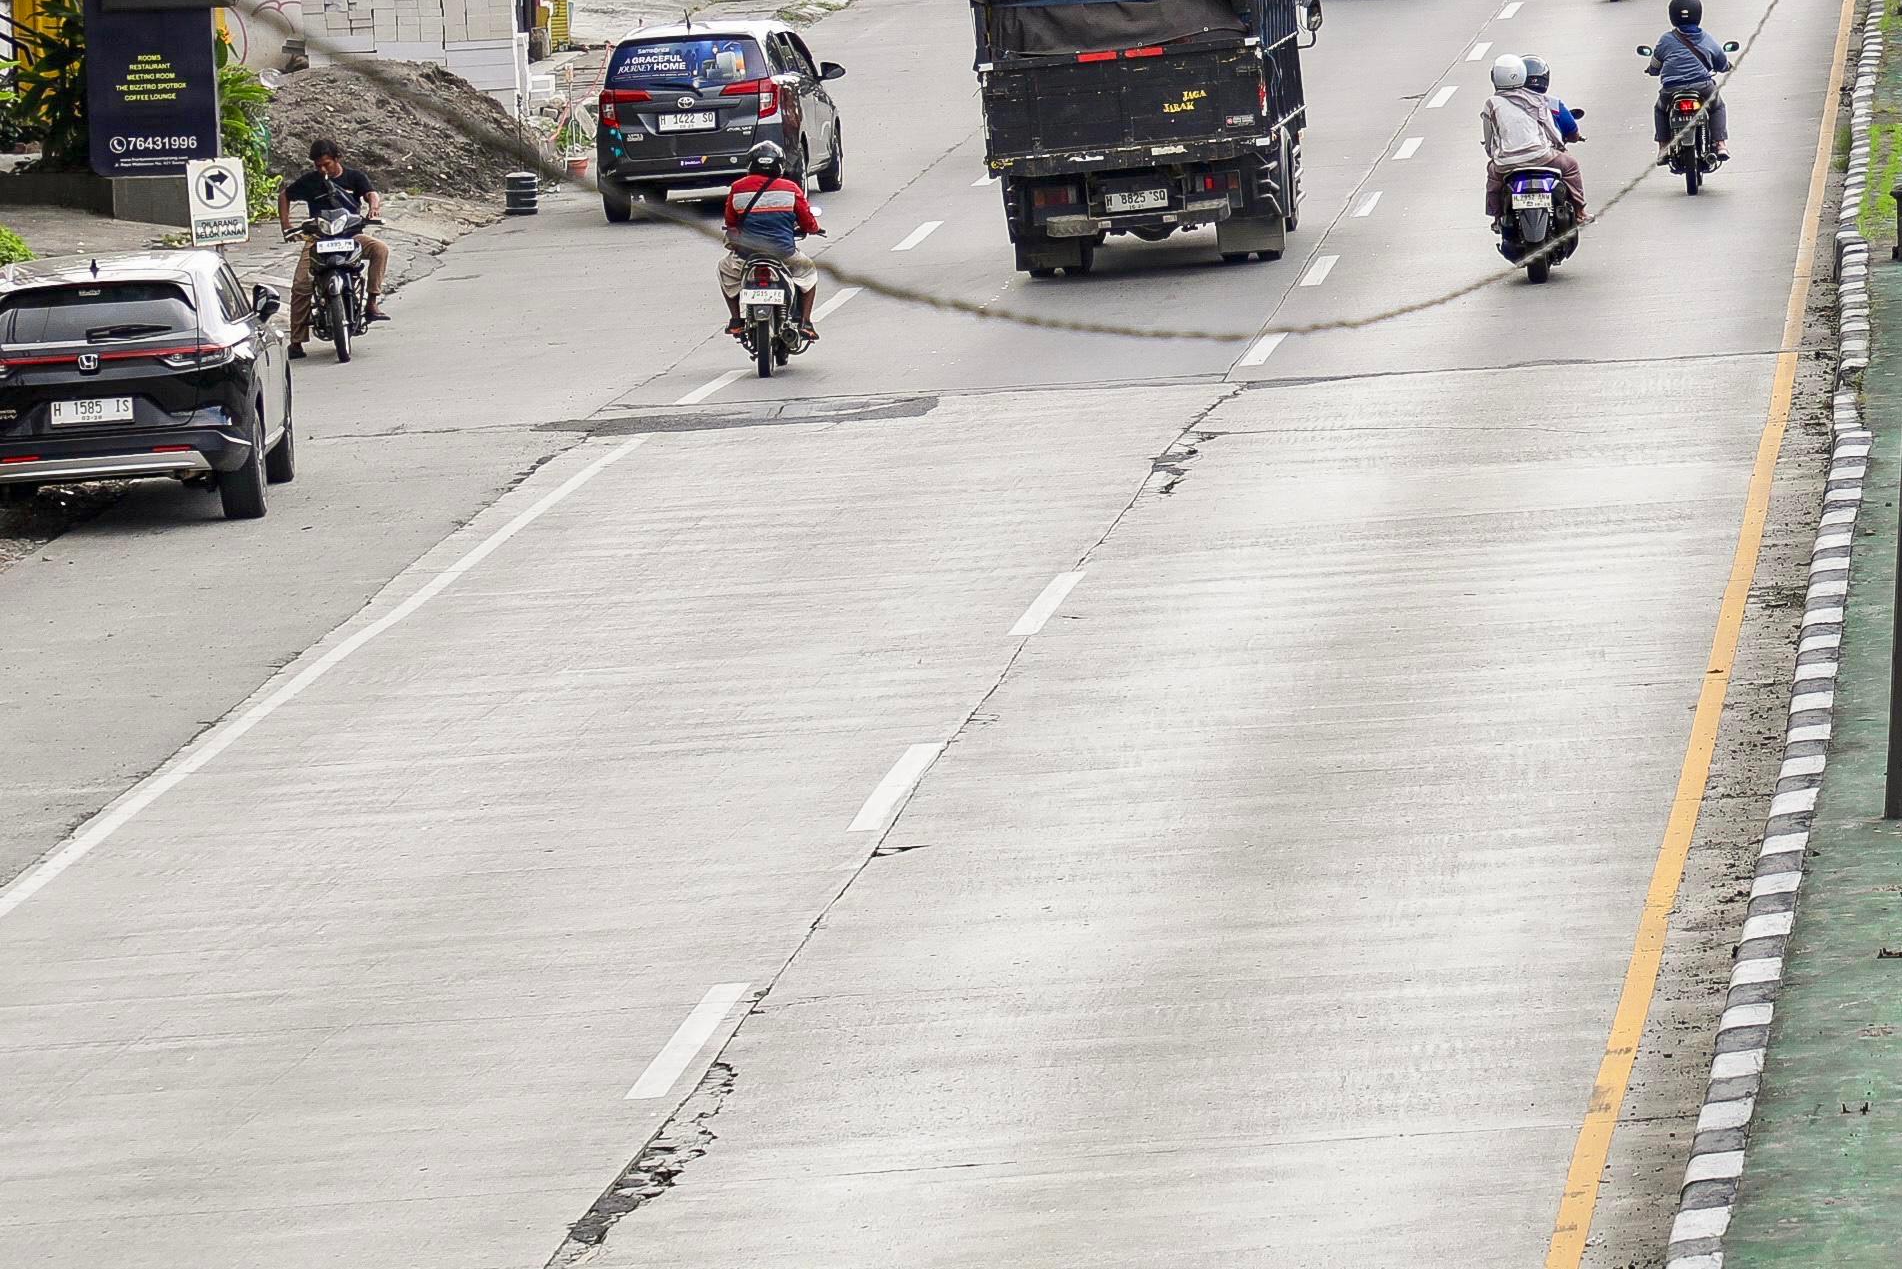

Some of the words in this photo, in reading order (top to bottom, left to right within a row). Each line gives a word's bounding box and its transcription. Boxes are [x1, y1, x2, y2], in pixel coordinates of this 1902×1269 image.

[632, 54, 682, 63] GRACEFUL
[618, 64, 653, 75] JOURNEY
[653, 62, 686, 70] HOME
[1182, 90, 1207, 101] JAGA
[660, 115, 666, 124] H
[672, 114, 695, 124] 1422
[128, 136, 197, 150] 76431996
[1106, 195, 1112, 207] H
[1121, 192, 1146, 204] 8825
[201, 220, 238, 229] DILARANG
[196, 231, 219, 239] BELOK
[54, 404, 62, 416] H
[74, 401, 102, 415] 1585
[116, 400, 129, 412] IS
